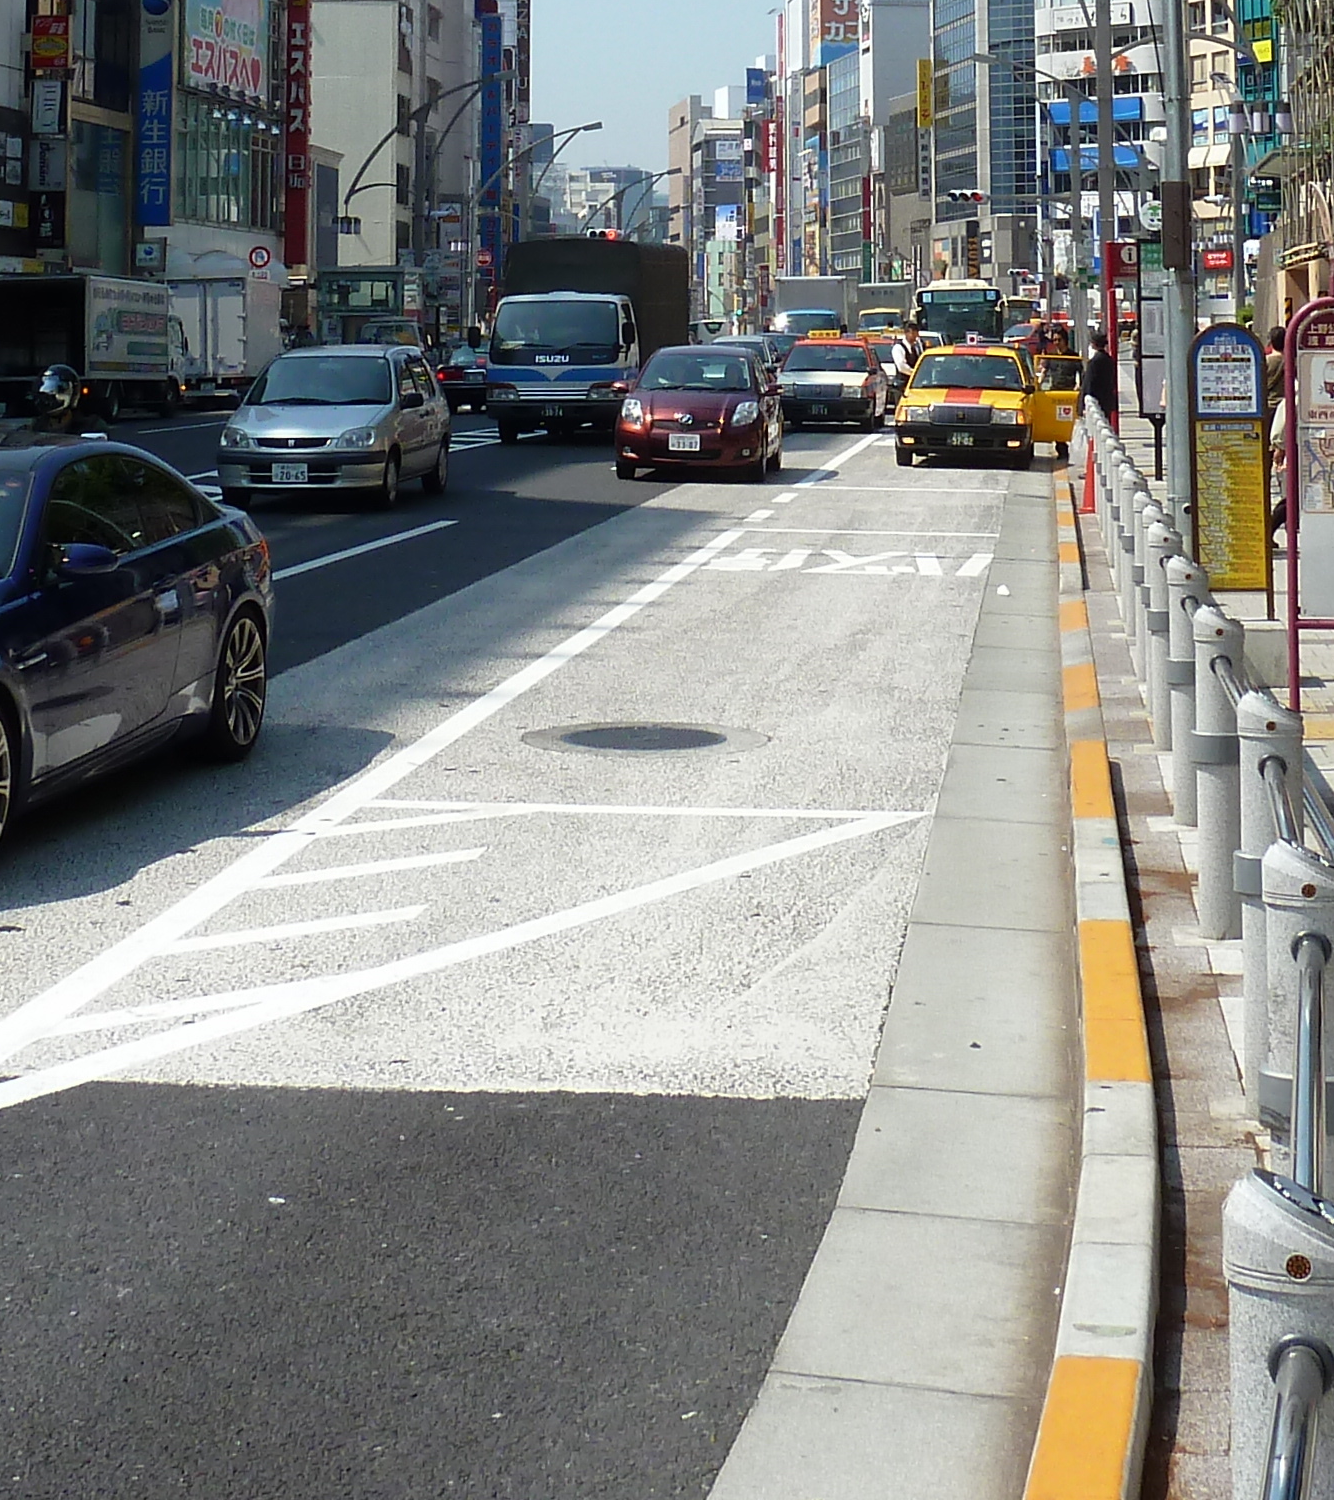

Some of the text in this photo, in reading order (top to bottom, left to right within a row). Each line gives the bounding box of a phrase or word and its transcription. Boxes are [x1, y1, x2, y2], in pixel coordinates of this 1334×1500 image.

[140, 89, 168, 205] 新生銀行
[535, 355, 570, 364] ISUZU
